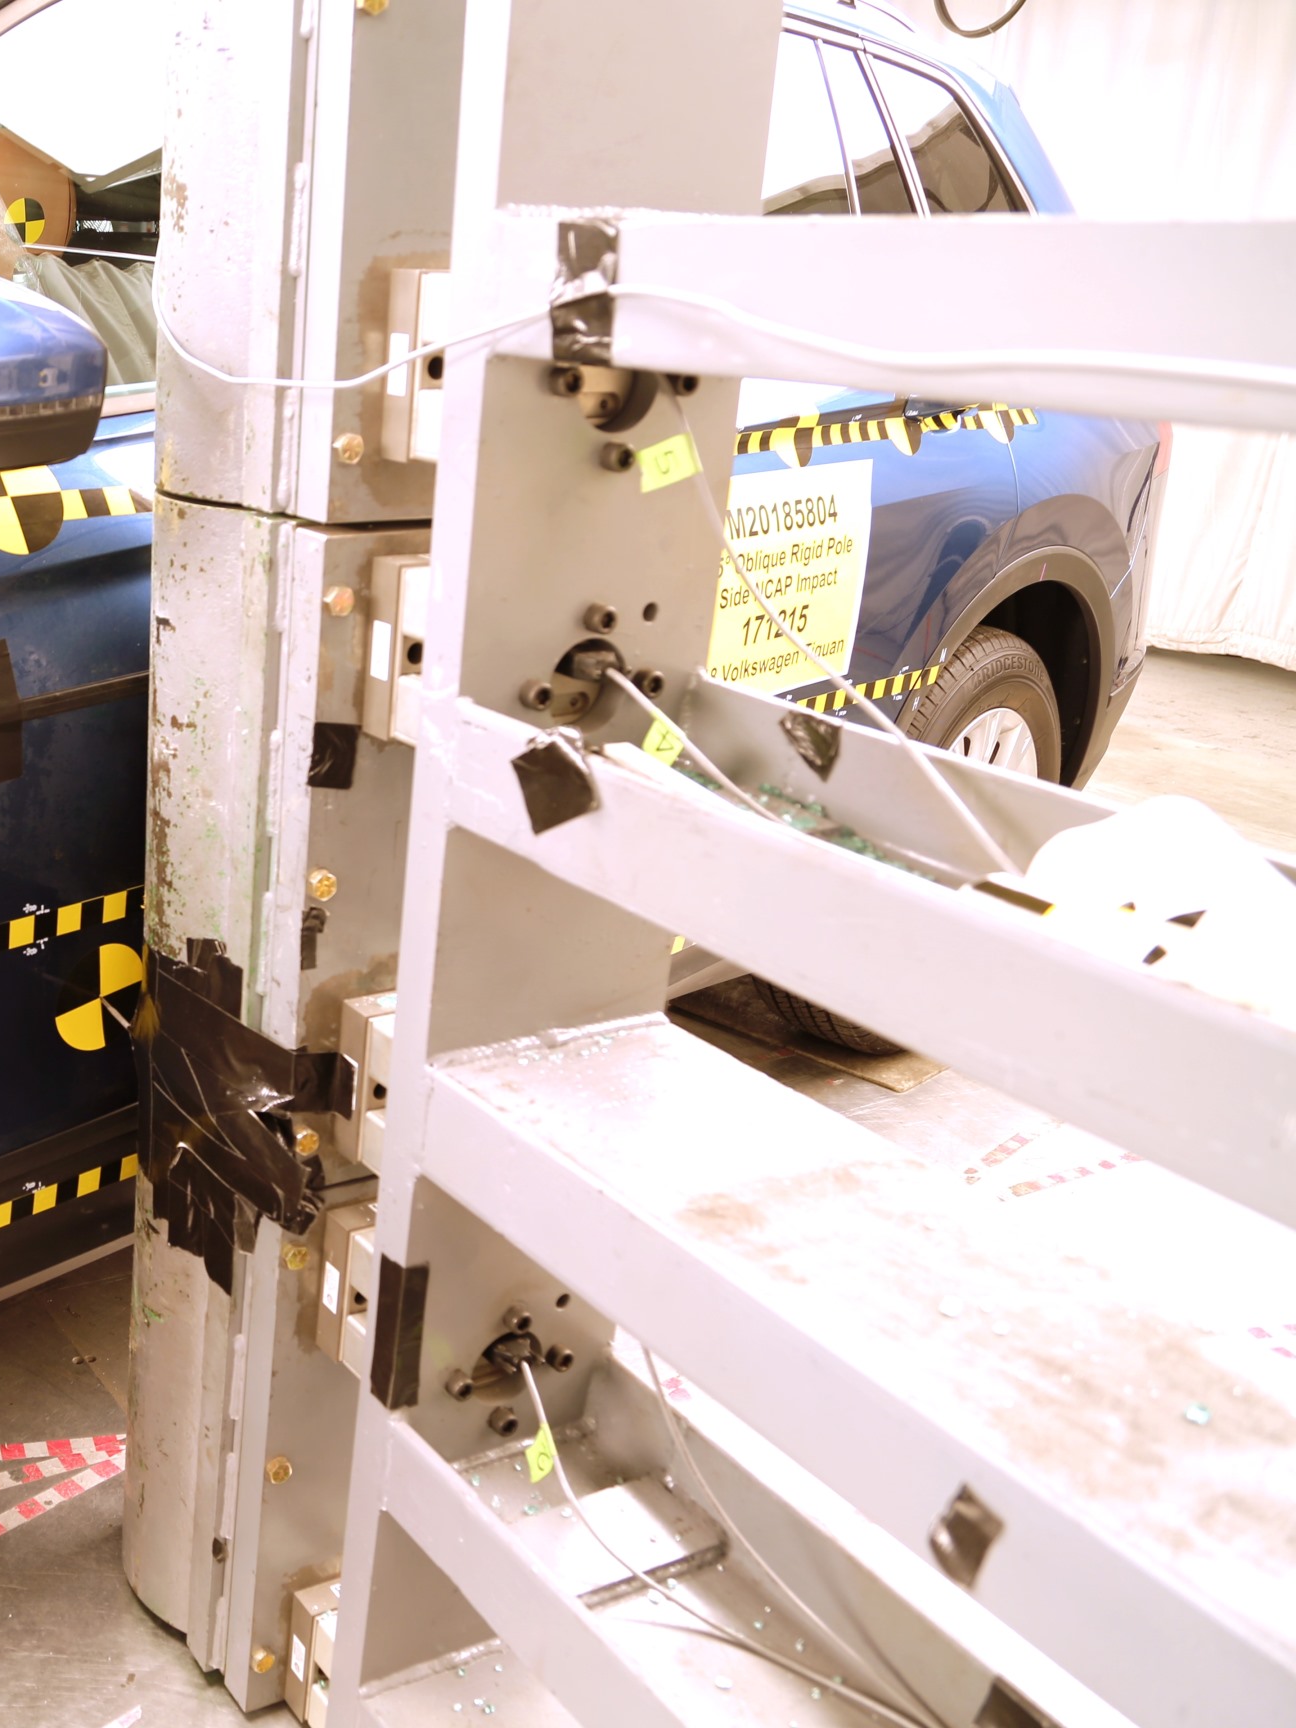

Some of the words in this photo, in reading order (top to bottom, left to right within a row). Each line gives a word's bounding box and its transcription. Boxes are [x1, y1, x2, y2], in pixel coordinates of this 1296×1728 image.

[726, 495, 838, 541] M20185804
[791, 542, 823, 567] Rigid
[827, 536, 853, 556] Pole
[720, 585, 750, 609] Side
[796, 569, 838, 595] Impact
[743, 604, 809, 646] 171215
[722, 650, 800, 682] Volkswagen
